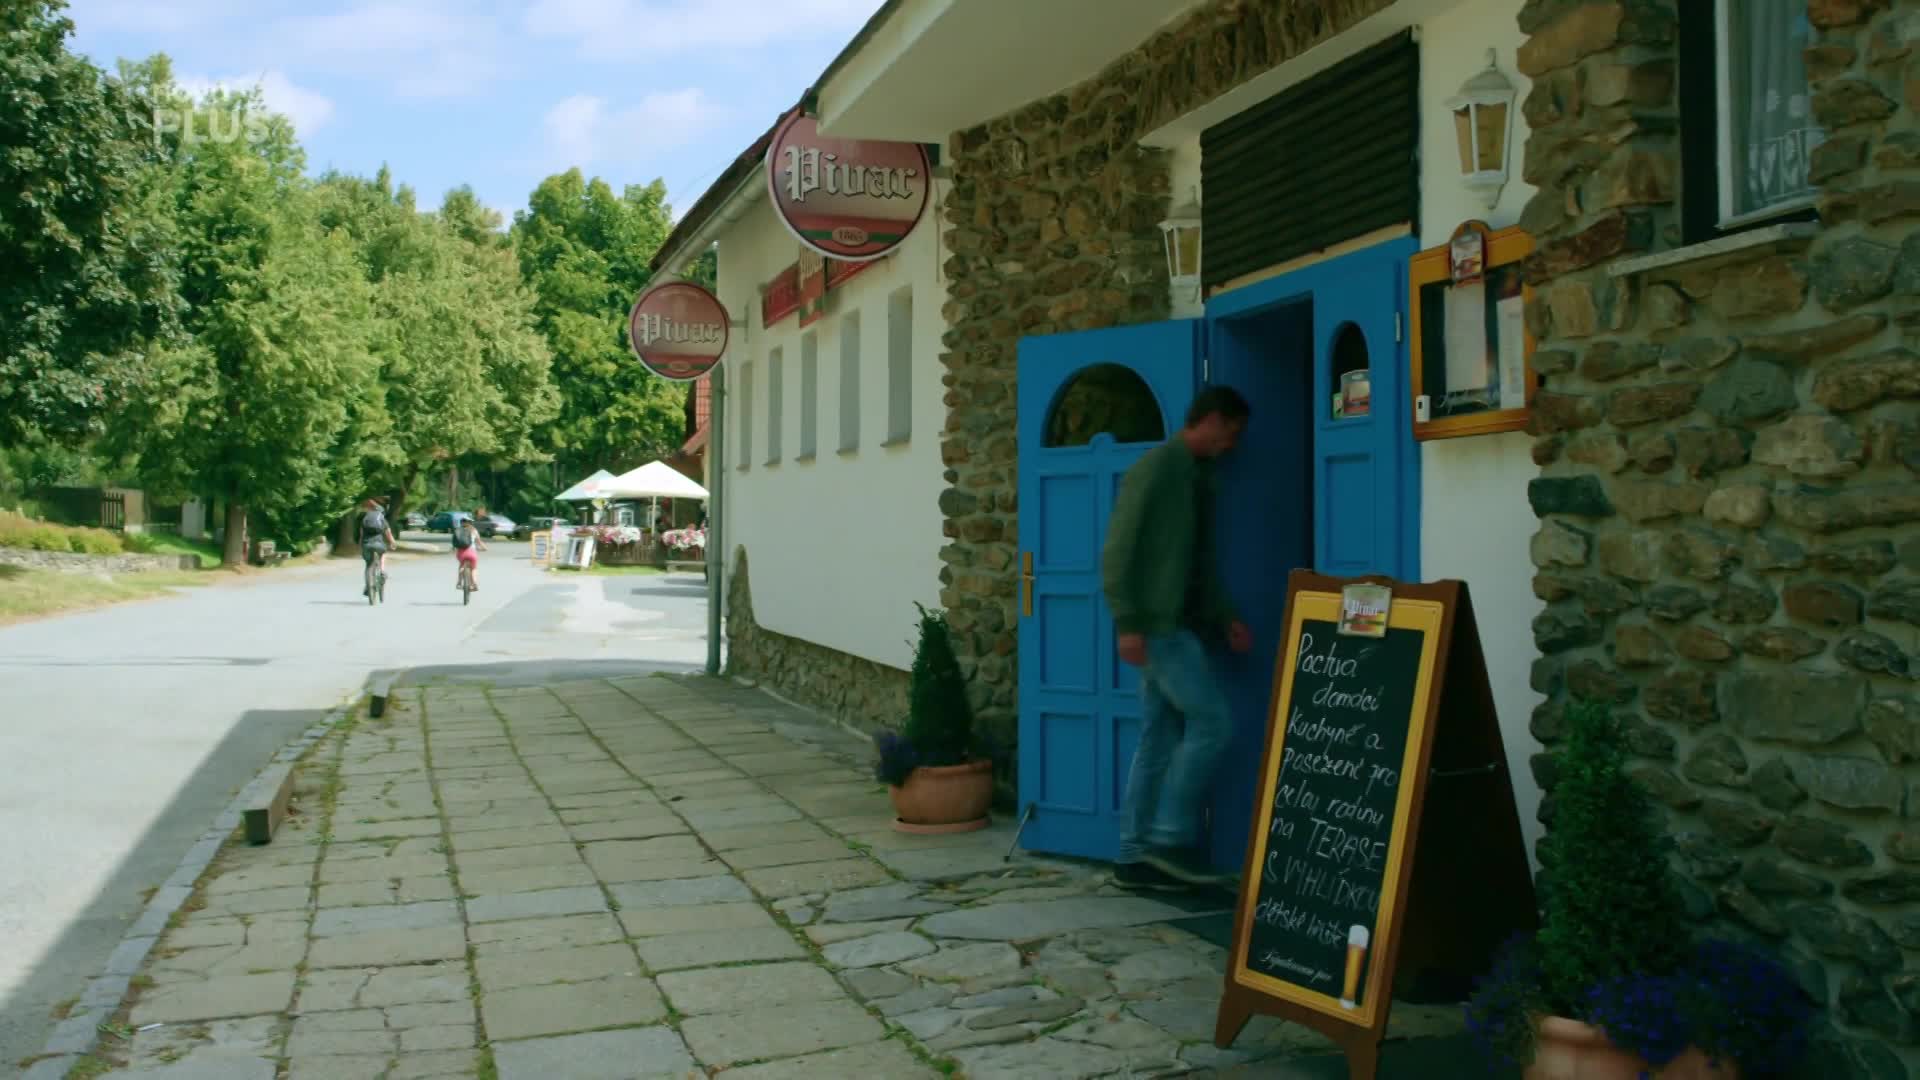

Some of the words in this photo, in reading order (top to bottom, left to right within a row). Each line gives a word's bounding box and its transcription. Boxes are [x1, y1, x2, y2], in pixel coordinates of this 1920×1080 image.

[1364, 733, 1384, 750] a
[1366, 764, 1398, 795] pro
[1271, 817, 1295, 839] na
[1306, 816, 1386, 869] TERASE
